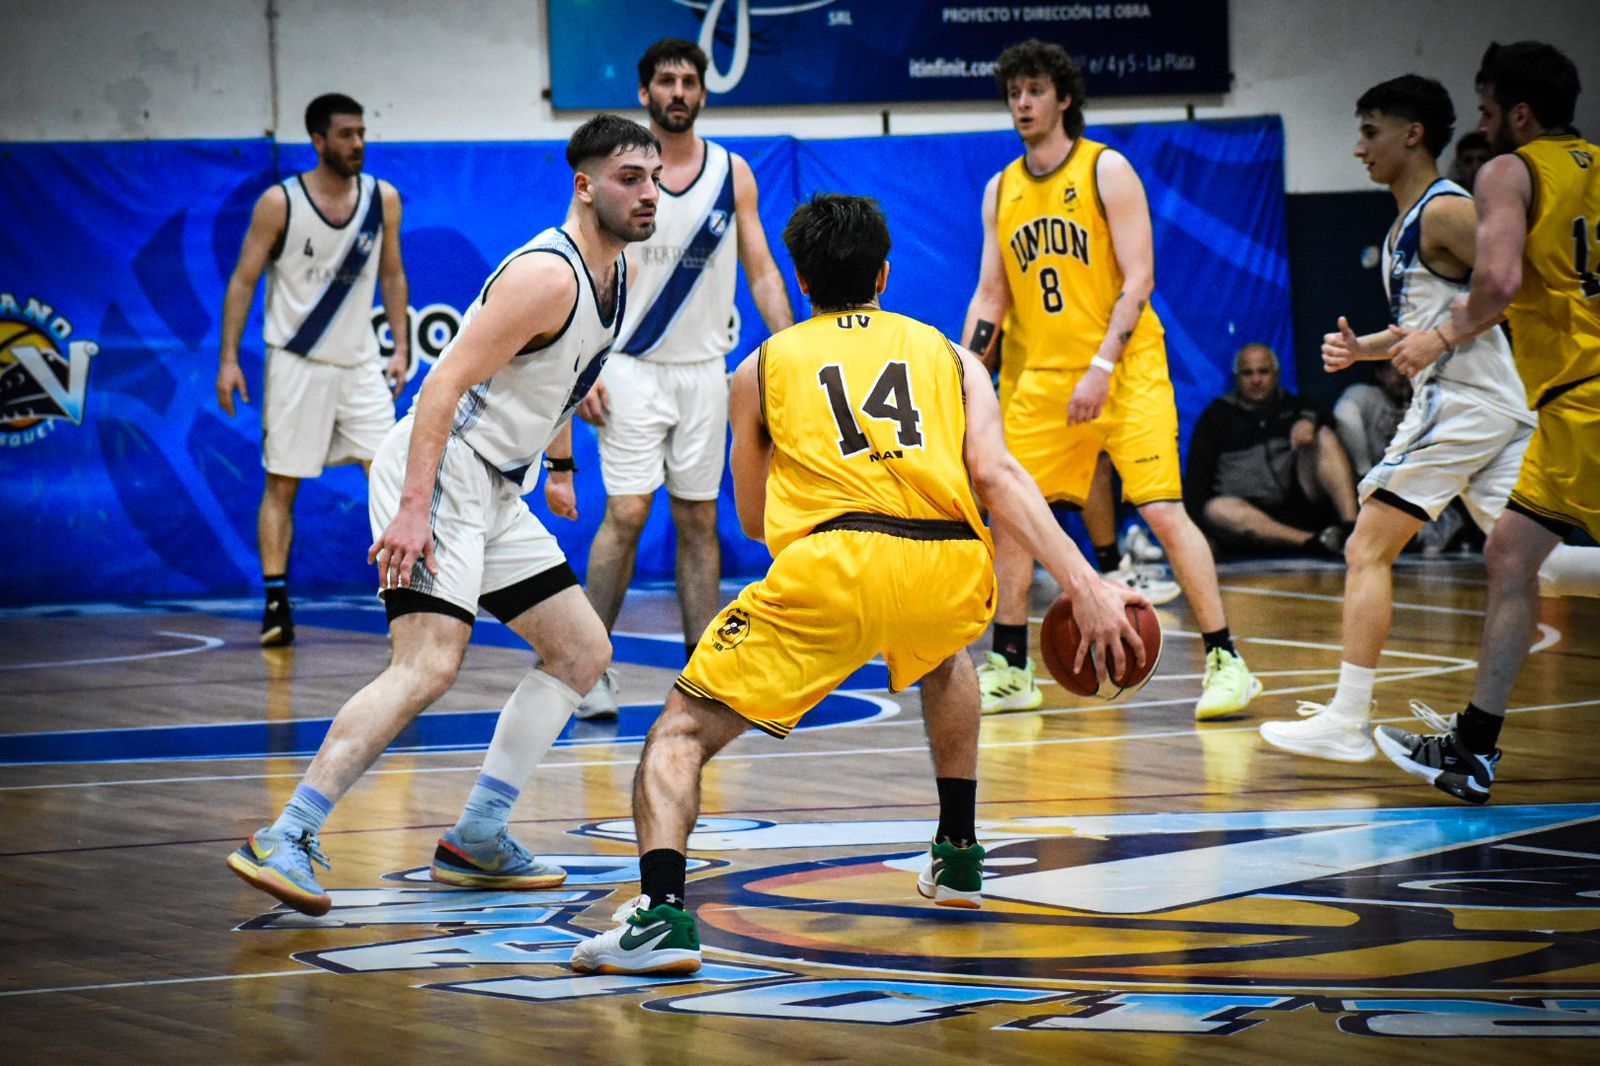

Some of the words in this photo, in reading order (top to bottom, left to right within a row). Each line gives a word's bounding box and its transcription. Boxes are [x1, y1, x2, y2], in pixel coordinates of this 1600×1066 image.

[828, 11, 853, 25] SRL
[943, 7, 1010, 22] PROYECTO
[1012, 7, 1021, 21] Y
[1023, 4, 1092, 21] DIRECCIÓN
[1095, 5, 1111, 19] DE
[1114, 3, 1151, 19] OBRA
[304, 237, 314, 257] 4
[1010, 217, 1089, 273] UNION
[1040, 267, 1063, 313] 8
[837, 314, 871, 329] UV
[818, 361, 924, 458] 14
